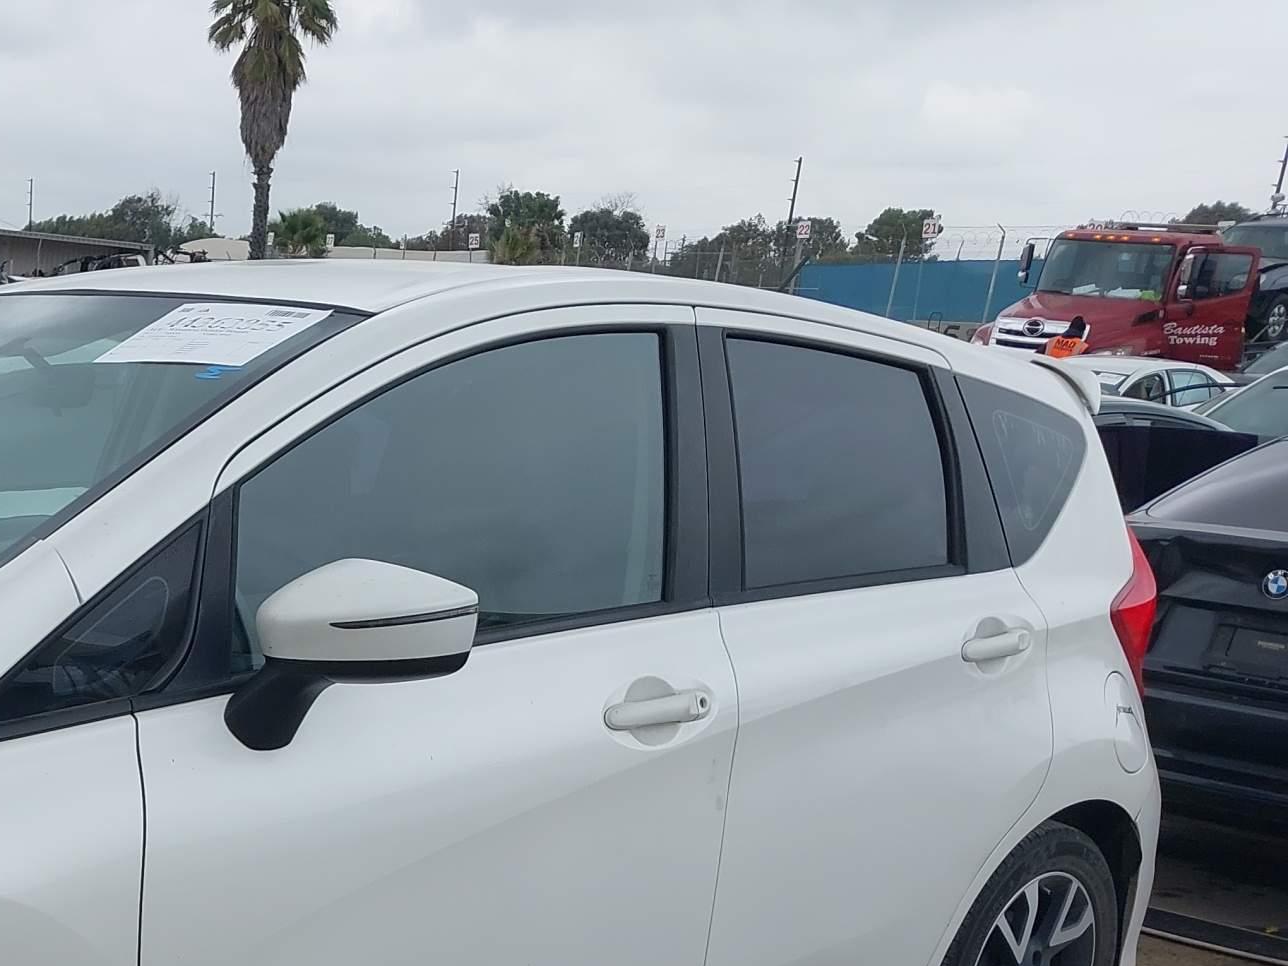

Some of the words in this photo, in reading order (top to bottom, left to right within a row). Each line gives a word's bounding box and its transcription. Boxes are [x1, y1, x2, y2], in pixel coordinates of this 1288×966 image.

[655, 228, 666, 239] 23
[798, 224, 810, 236] 22
[923, 222, 937, 235] 21
[469, 236, 479, 246] 25
[1163, 322, 1226, 335] Bautista
[1168, 335, 1218, 346] Towing
